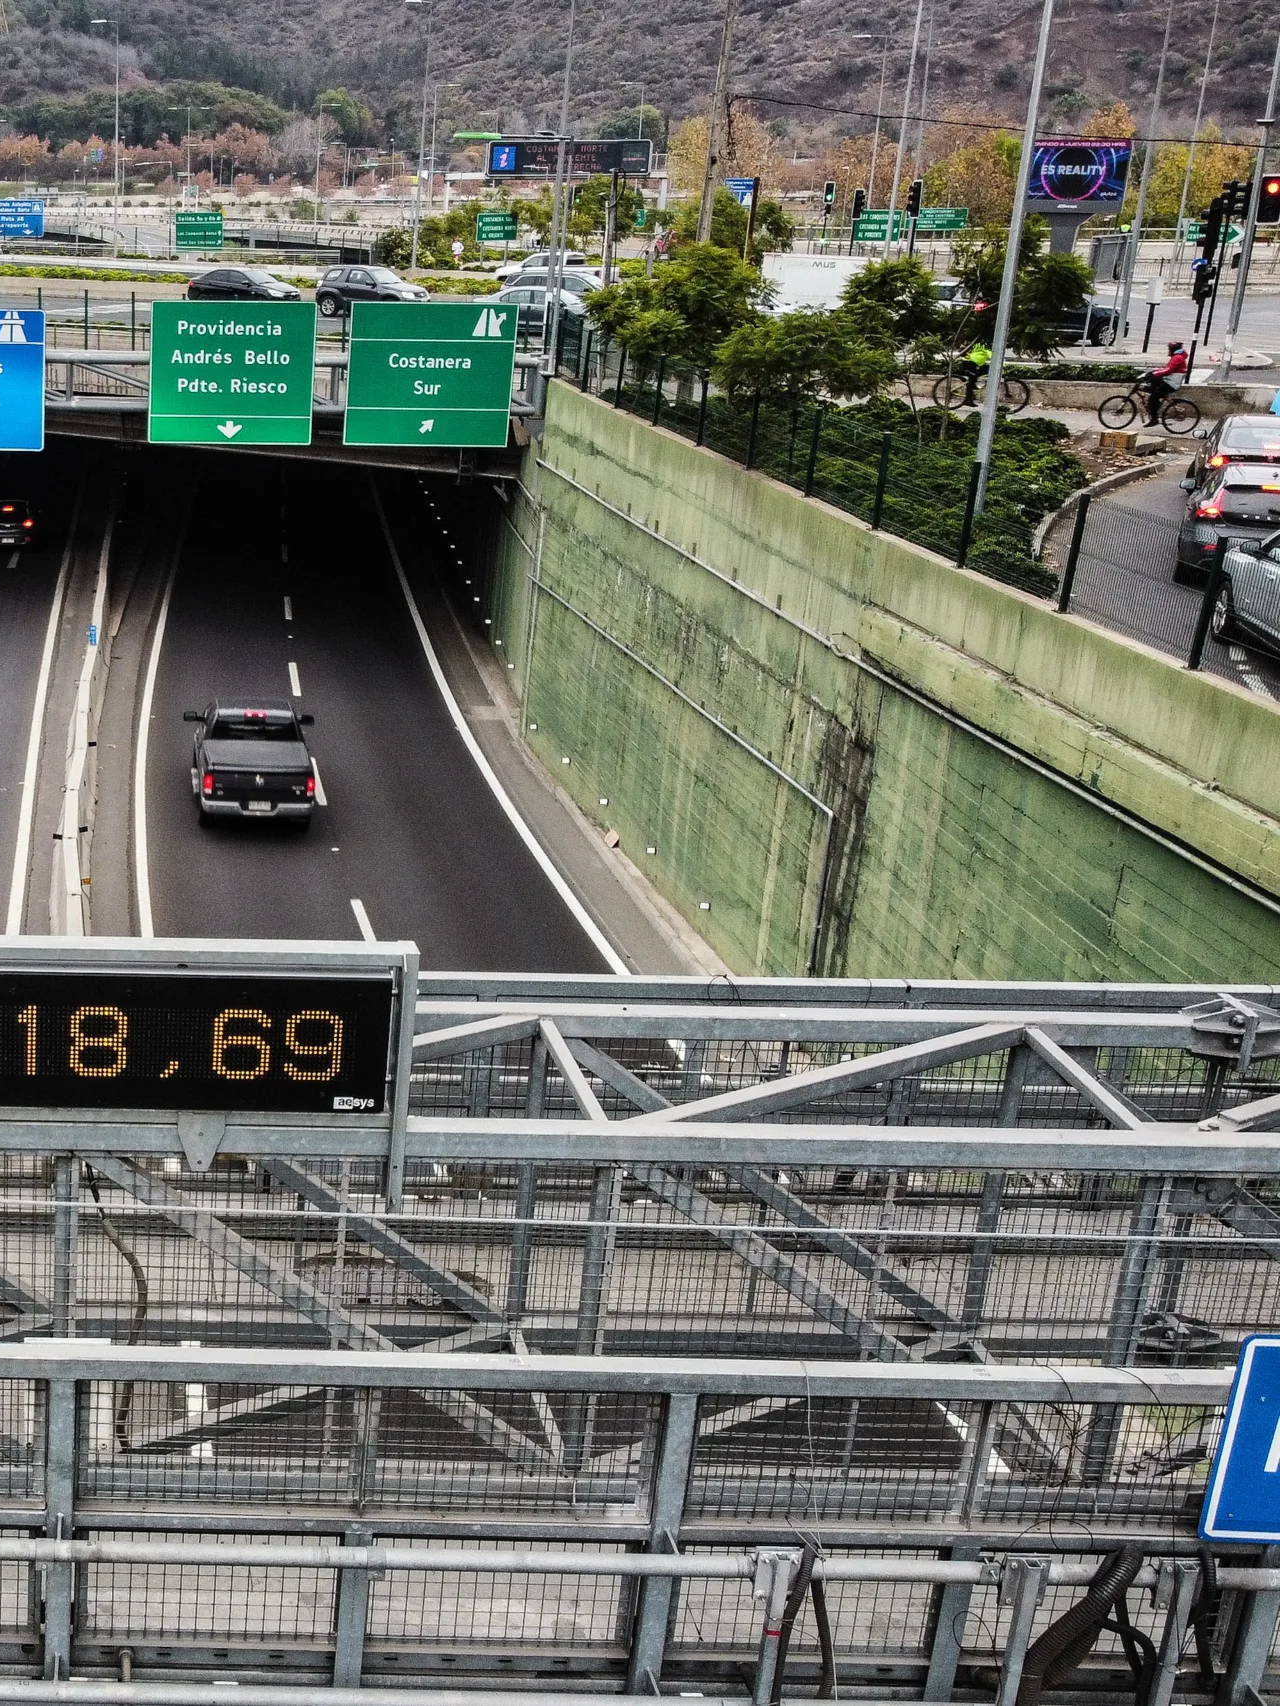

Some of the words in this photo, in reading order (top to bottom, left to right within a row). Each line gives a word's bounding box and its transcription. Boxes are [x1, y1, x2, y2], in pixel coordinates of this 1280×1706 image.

[1057, 165, 1105, 175] REALITY
[177, 319, 282, 337] Providencia
[171, 348, 232, 365] Andrés
[244, 349, 290, 366] Bello
[388, 353, 472, 370] Costanera
[177, 378, 223, 394] Pdte.
[230, 378, 287, 395] Riesco
[413, 380, 441, 396] Sur
[337, 1097, 375, 1109] aesys
